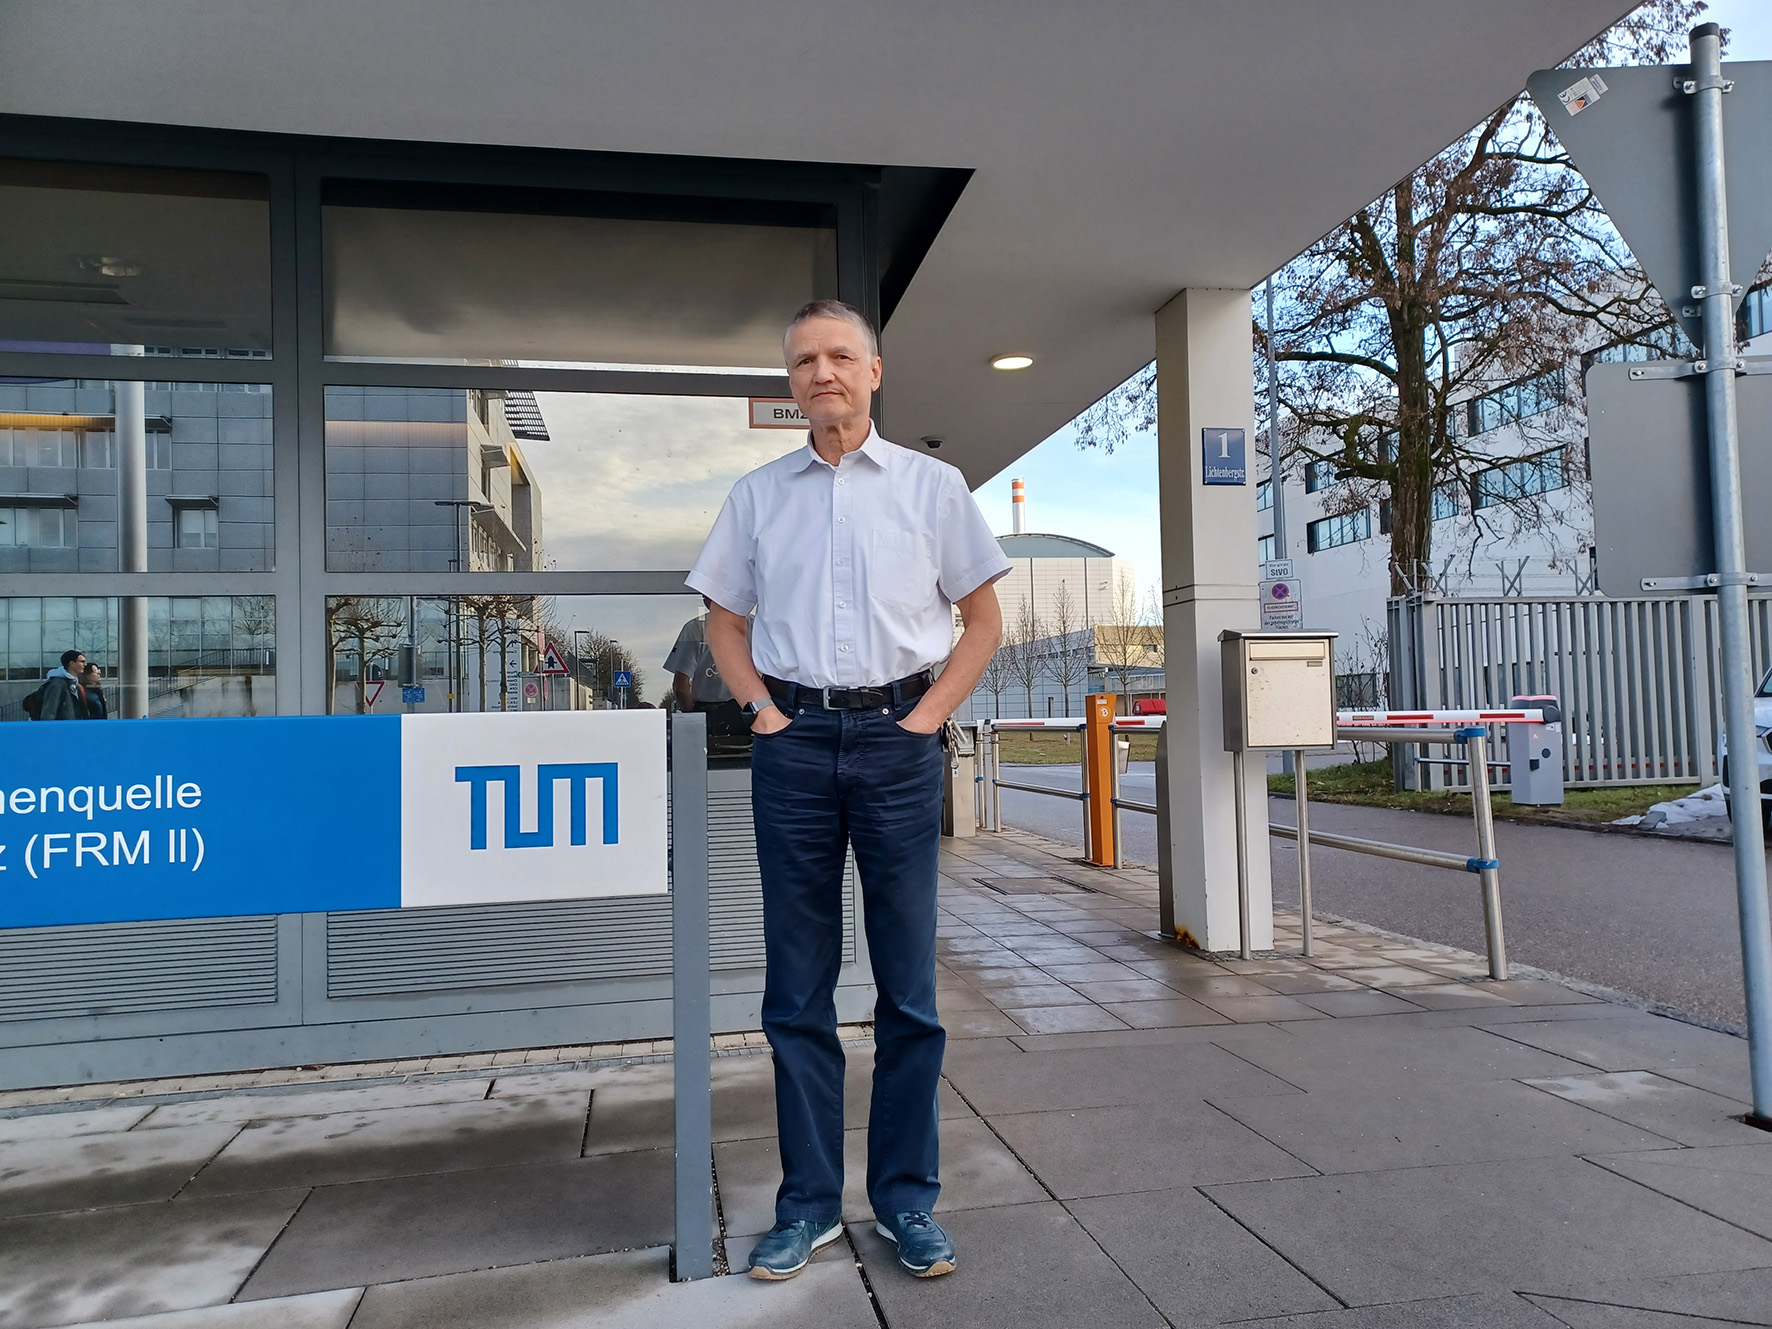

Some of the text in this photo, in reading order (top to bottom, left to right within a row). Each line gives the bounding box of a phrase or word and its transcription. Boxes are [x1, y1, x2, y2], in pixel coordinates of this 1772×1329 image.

[1217, 432, 1231, 458] 1
[0, 775, 202, 821] enquelle
[455, 762, 619, 851] TUM
[24, 830, 150, 879] (FRM
[168, 827, 205, 872] II)
